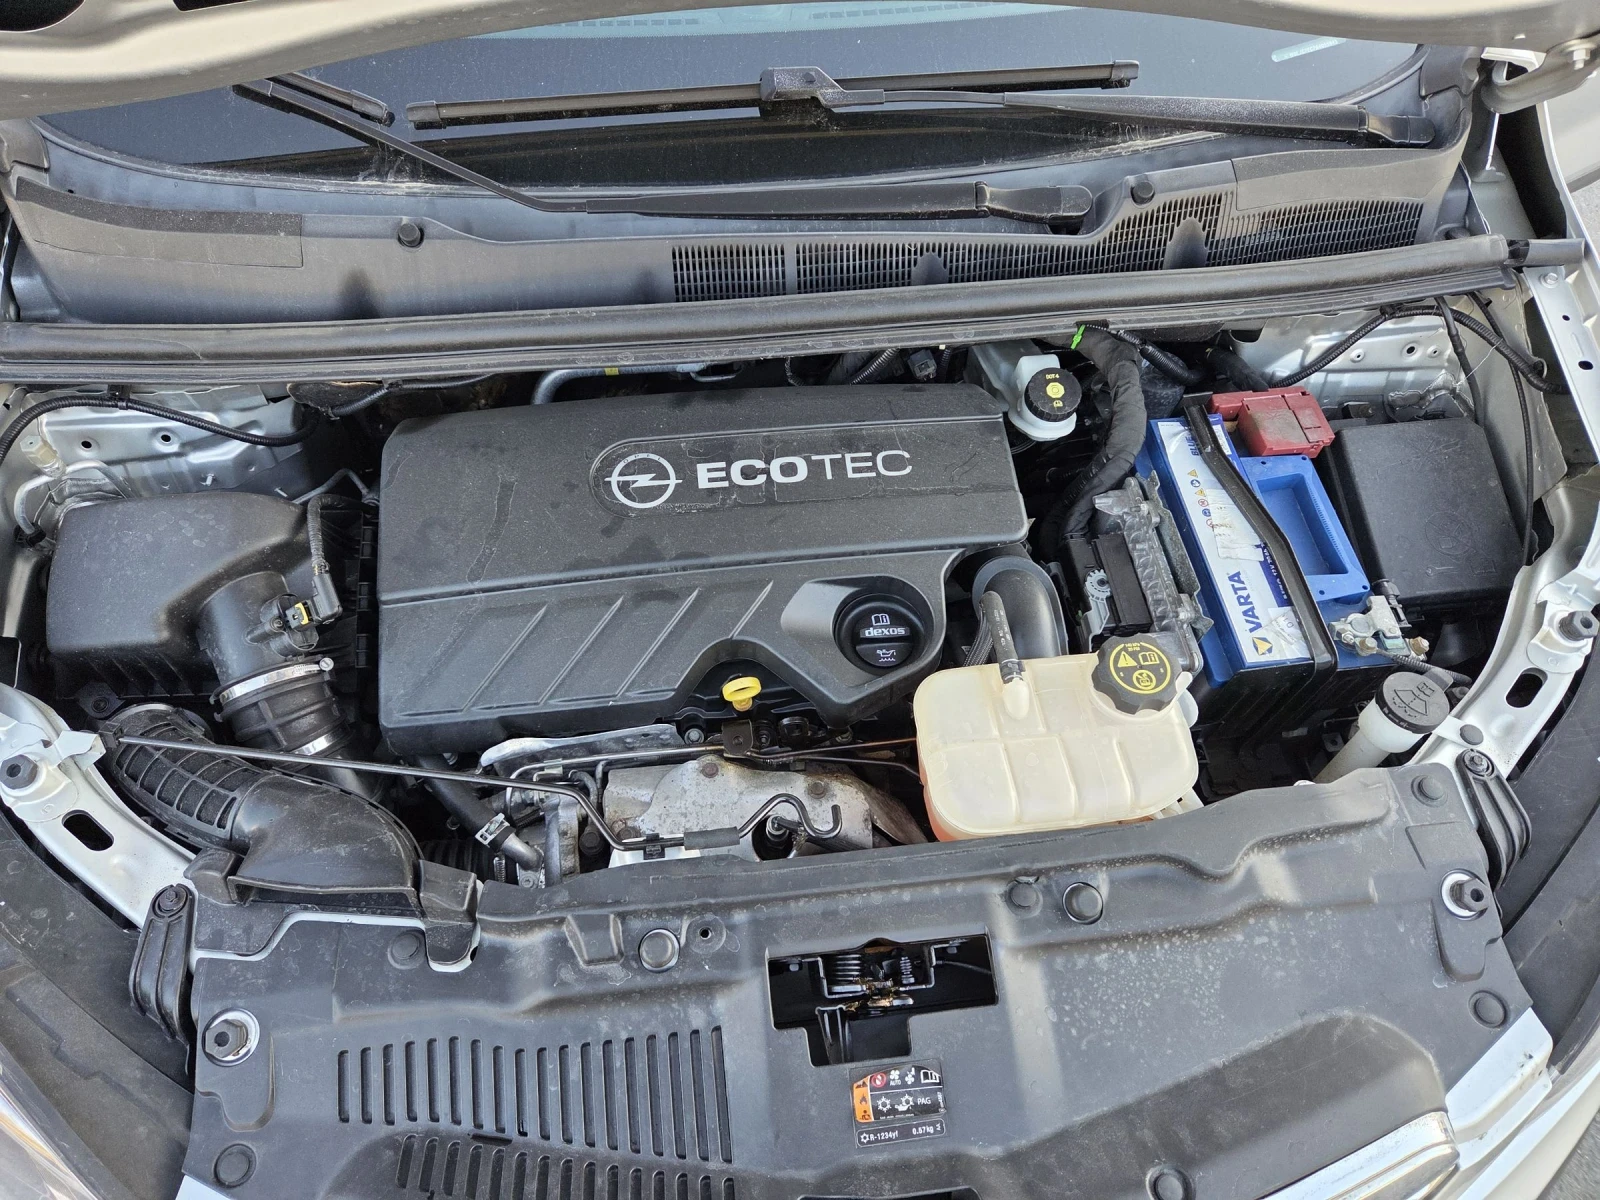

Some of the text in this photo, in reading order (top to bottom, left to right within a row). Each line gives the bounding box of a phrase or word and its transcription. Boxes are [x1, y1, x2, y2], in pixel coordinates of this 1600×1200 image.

[623, 454, 661, 464] OPEL
[697, 449, 912, 489] ECOTEC
[1227, 571, 1263, 633] VARTA
[864, 627, 906, 637] dexos
[917, 1097, 931, 1105] PAG
